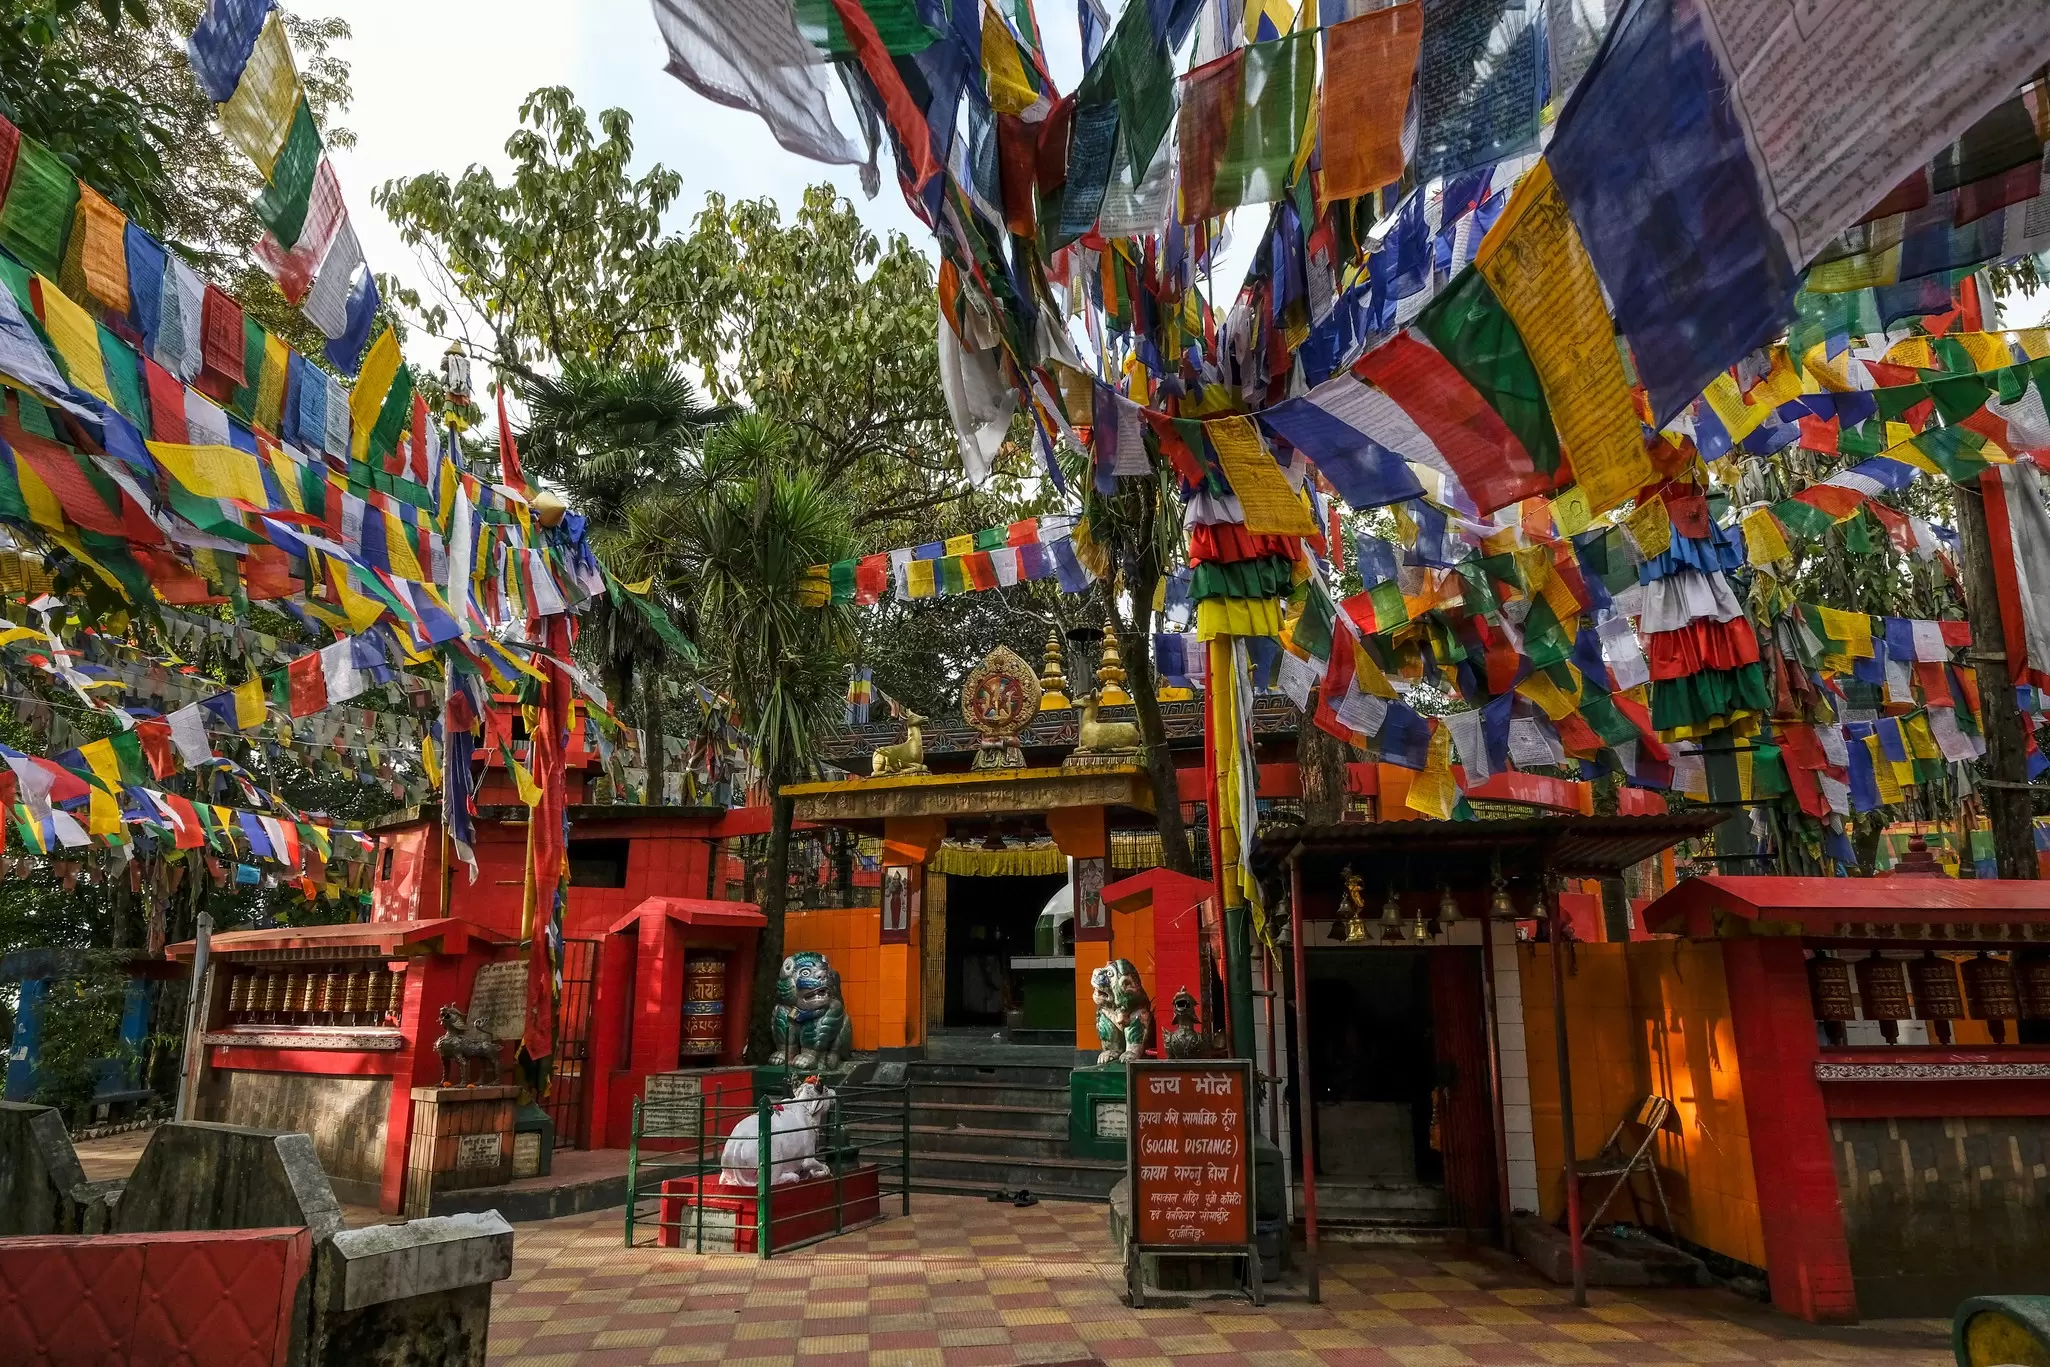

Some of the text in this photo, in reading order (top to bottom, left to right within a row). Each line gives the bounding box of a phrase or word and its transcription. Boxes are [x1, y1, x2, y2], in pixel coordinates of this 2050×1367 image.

[1150, 1072, 1232, 1096] जय भोले
[1138, 1112, 1161, 1129] कृपया
[1183, 1108, 1217, 1127] सामाजिक
[1221, 1108, 1237, 1131] दूरी
[1141, 1134, 1238, 1158] (SOCIAL DISTANCE)
[1140, 1166, 1168, 1180] कायम
[1151, 1193, 1179, 1205] महाकाल
